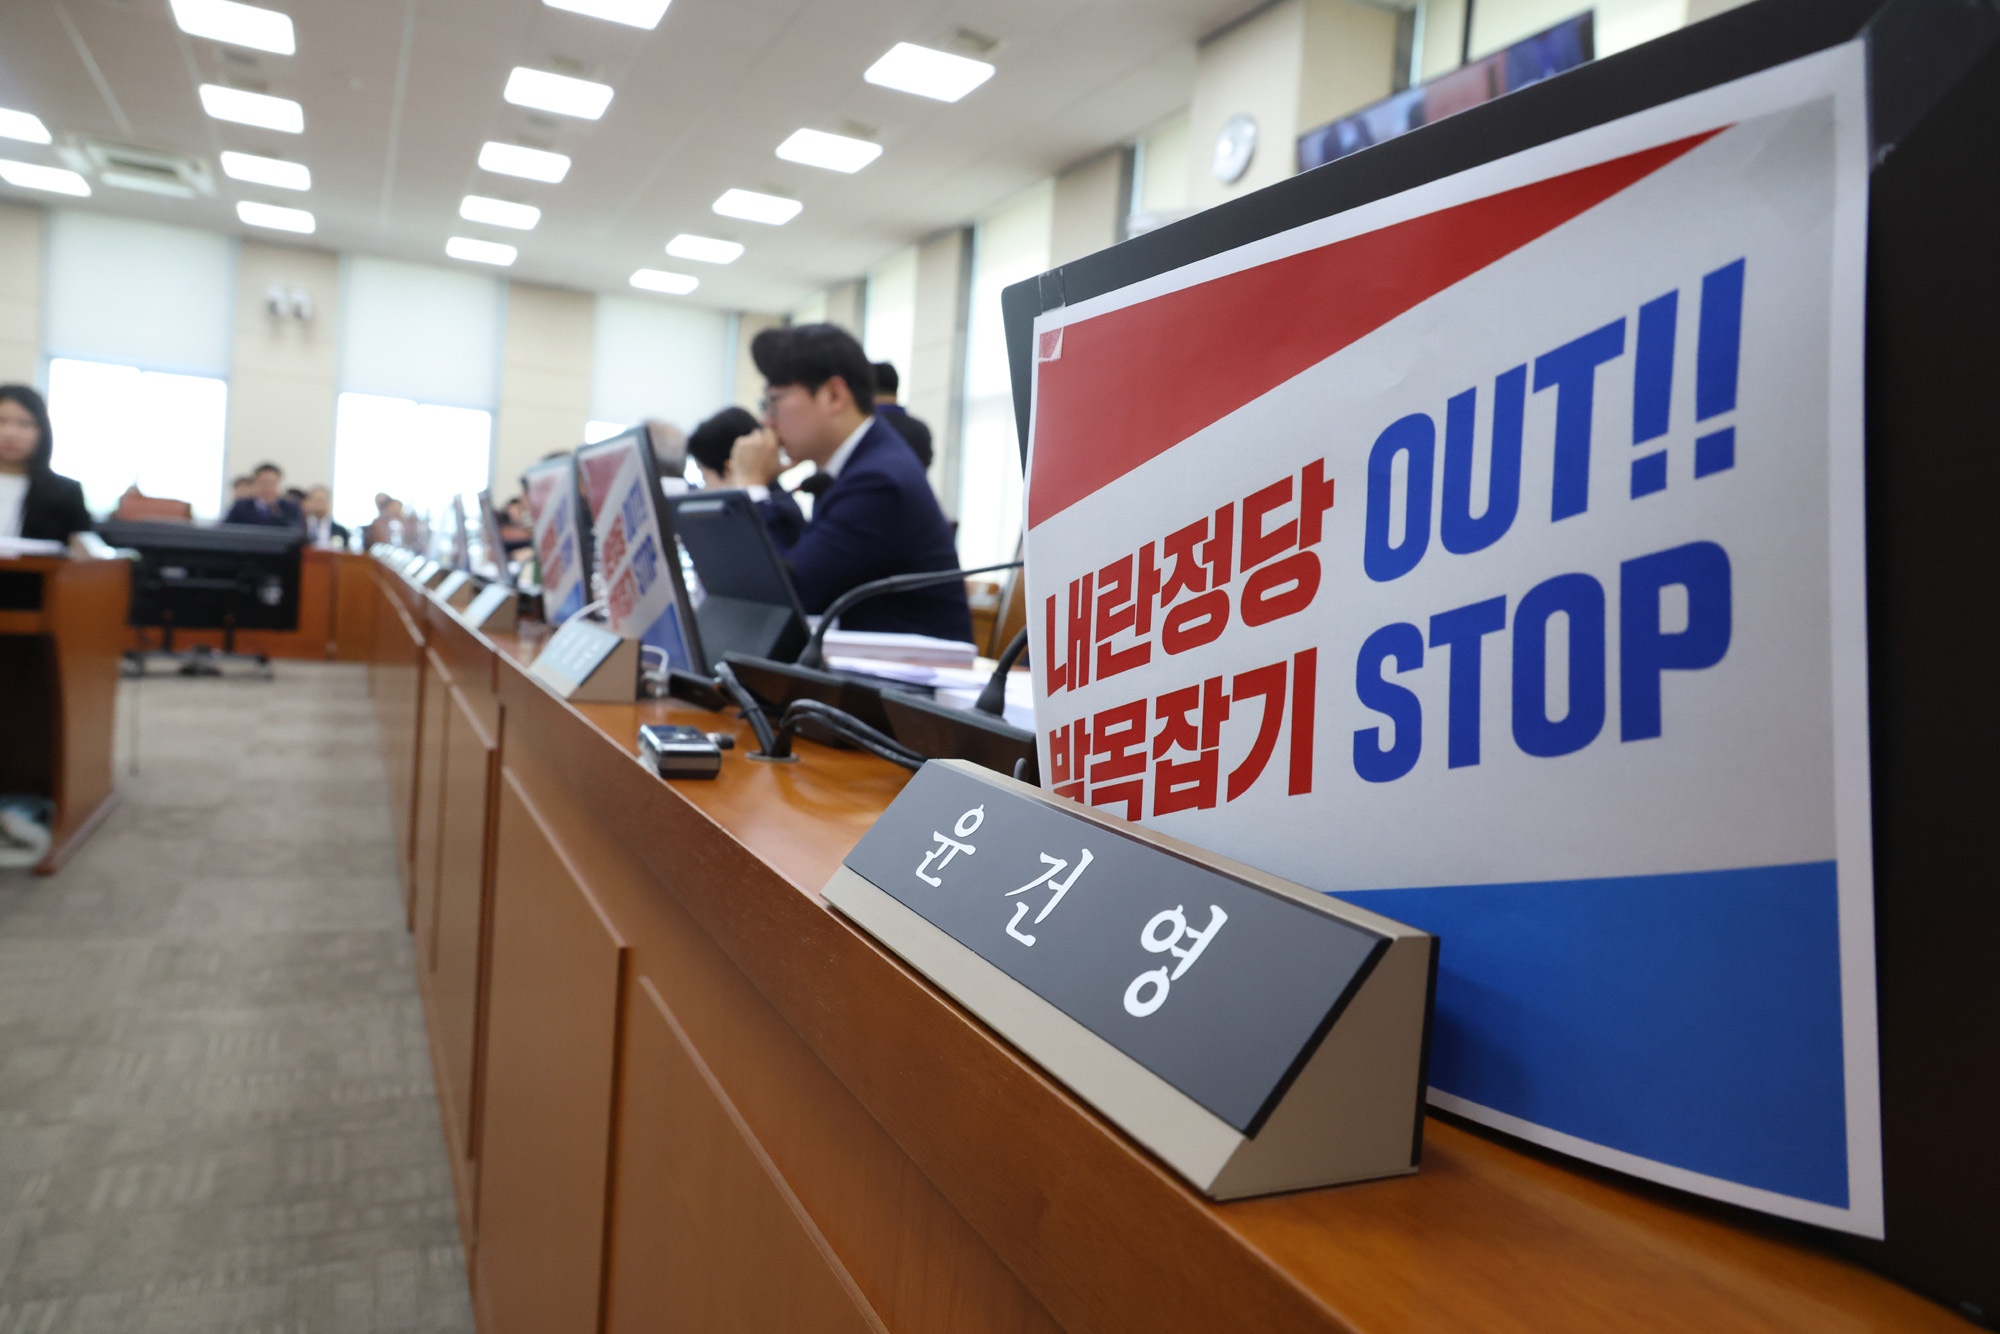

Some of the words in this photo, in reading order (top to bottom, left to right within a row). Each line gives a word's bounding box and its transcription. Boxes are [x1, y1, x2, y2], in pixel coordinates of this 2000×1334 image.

[1046, 457, 1334, 698] 내란정당
[1363, 256, 1746, 583] OUT!!
[1353, 540, 1732, 783] STOP
